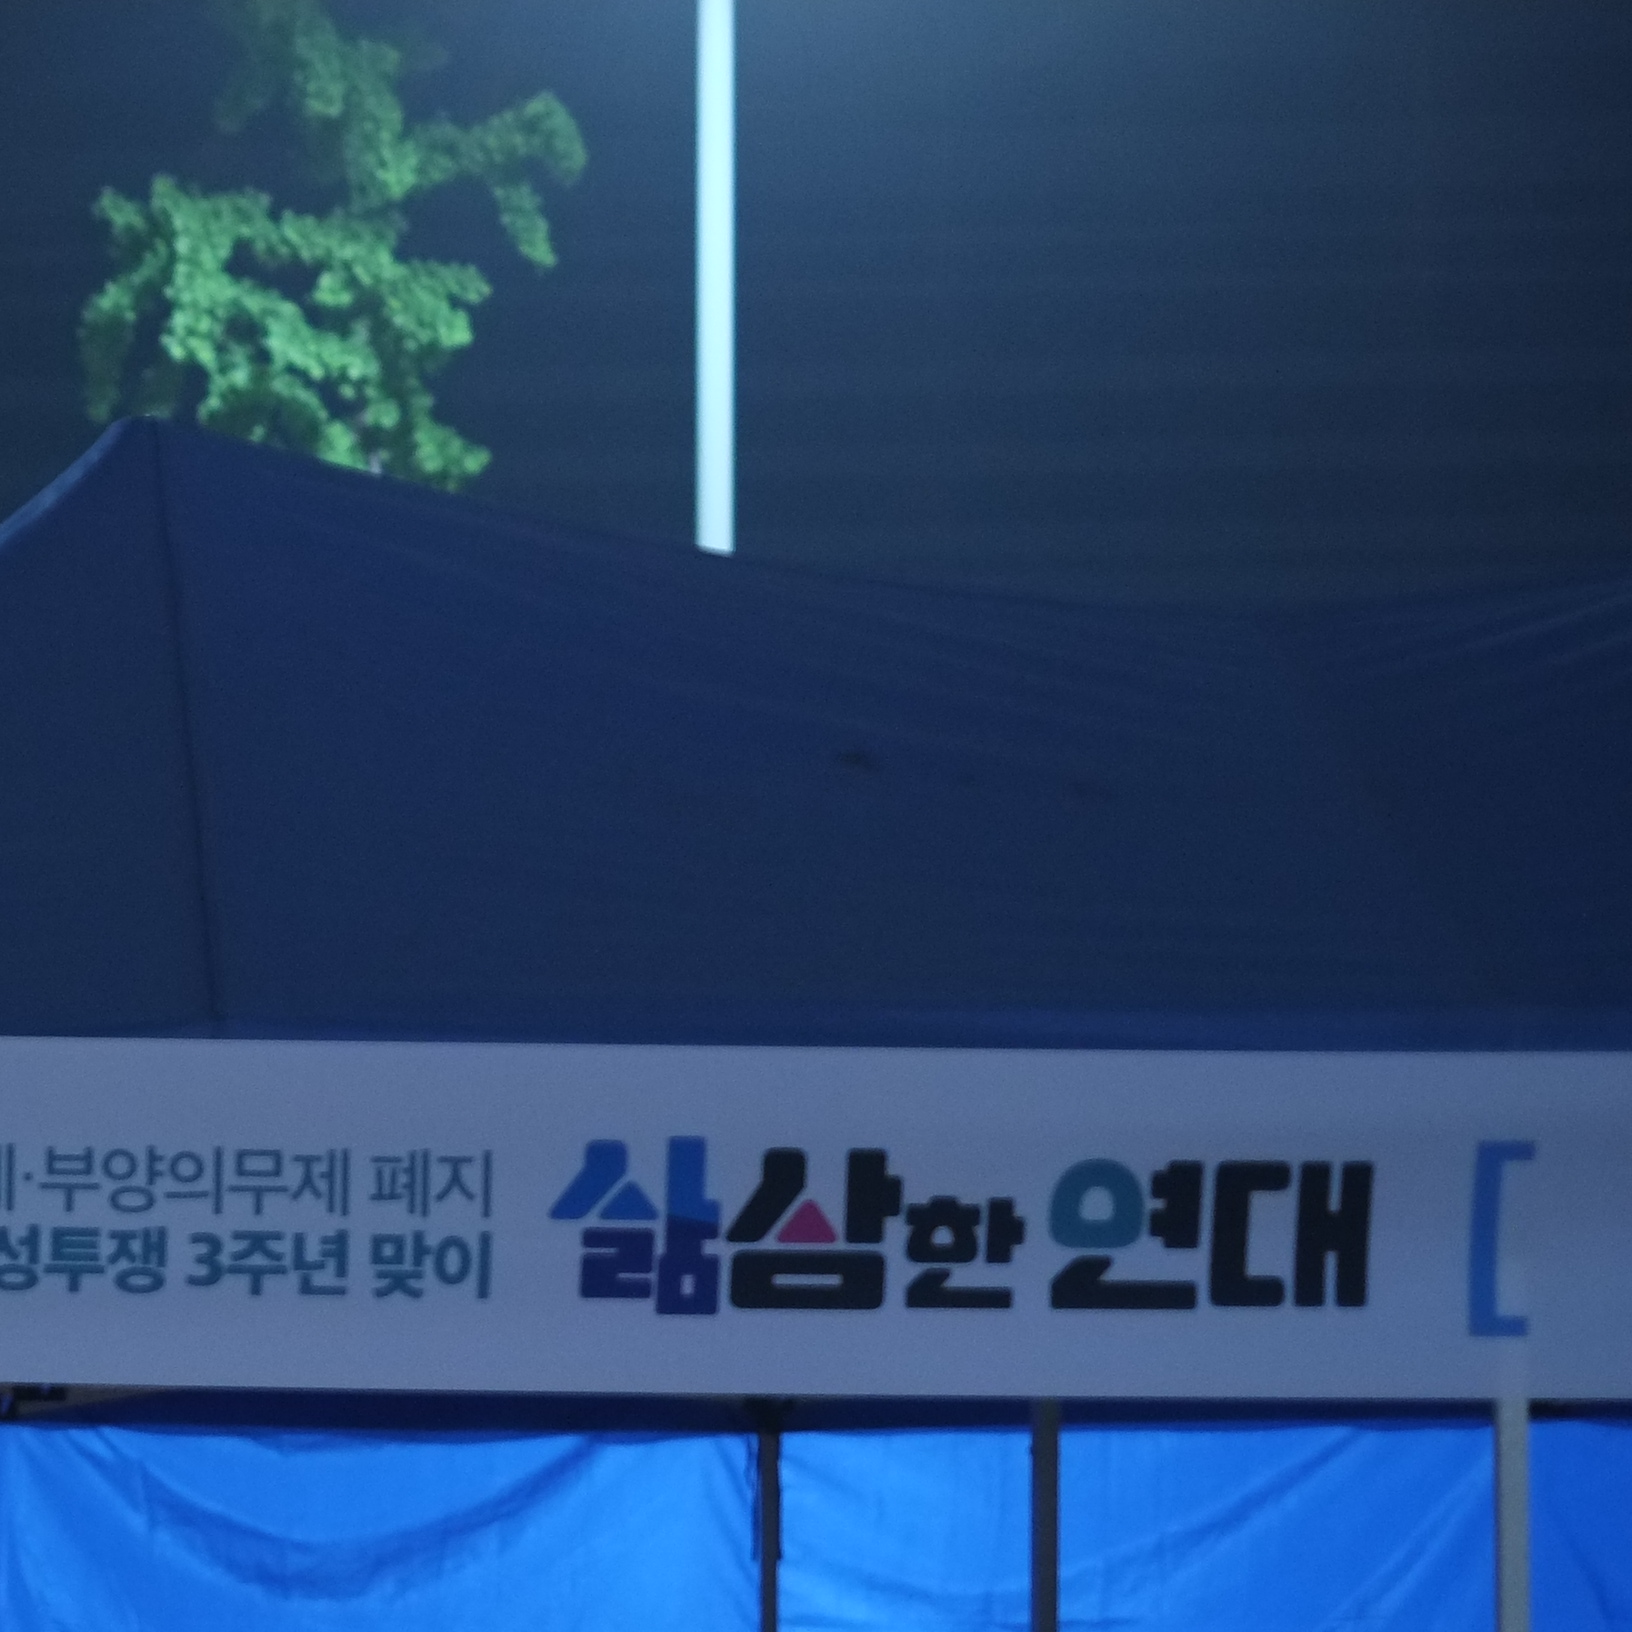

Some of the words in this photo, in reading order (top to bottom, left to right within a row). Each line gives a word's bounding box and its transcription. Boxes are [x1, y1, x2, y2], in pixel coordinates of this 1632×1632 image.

[369, 1147, 493, 1219] 폐지
[184, 1228, 350, 1297] 3주년
[369, 1229, 493, 1301] 맞이
